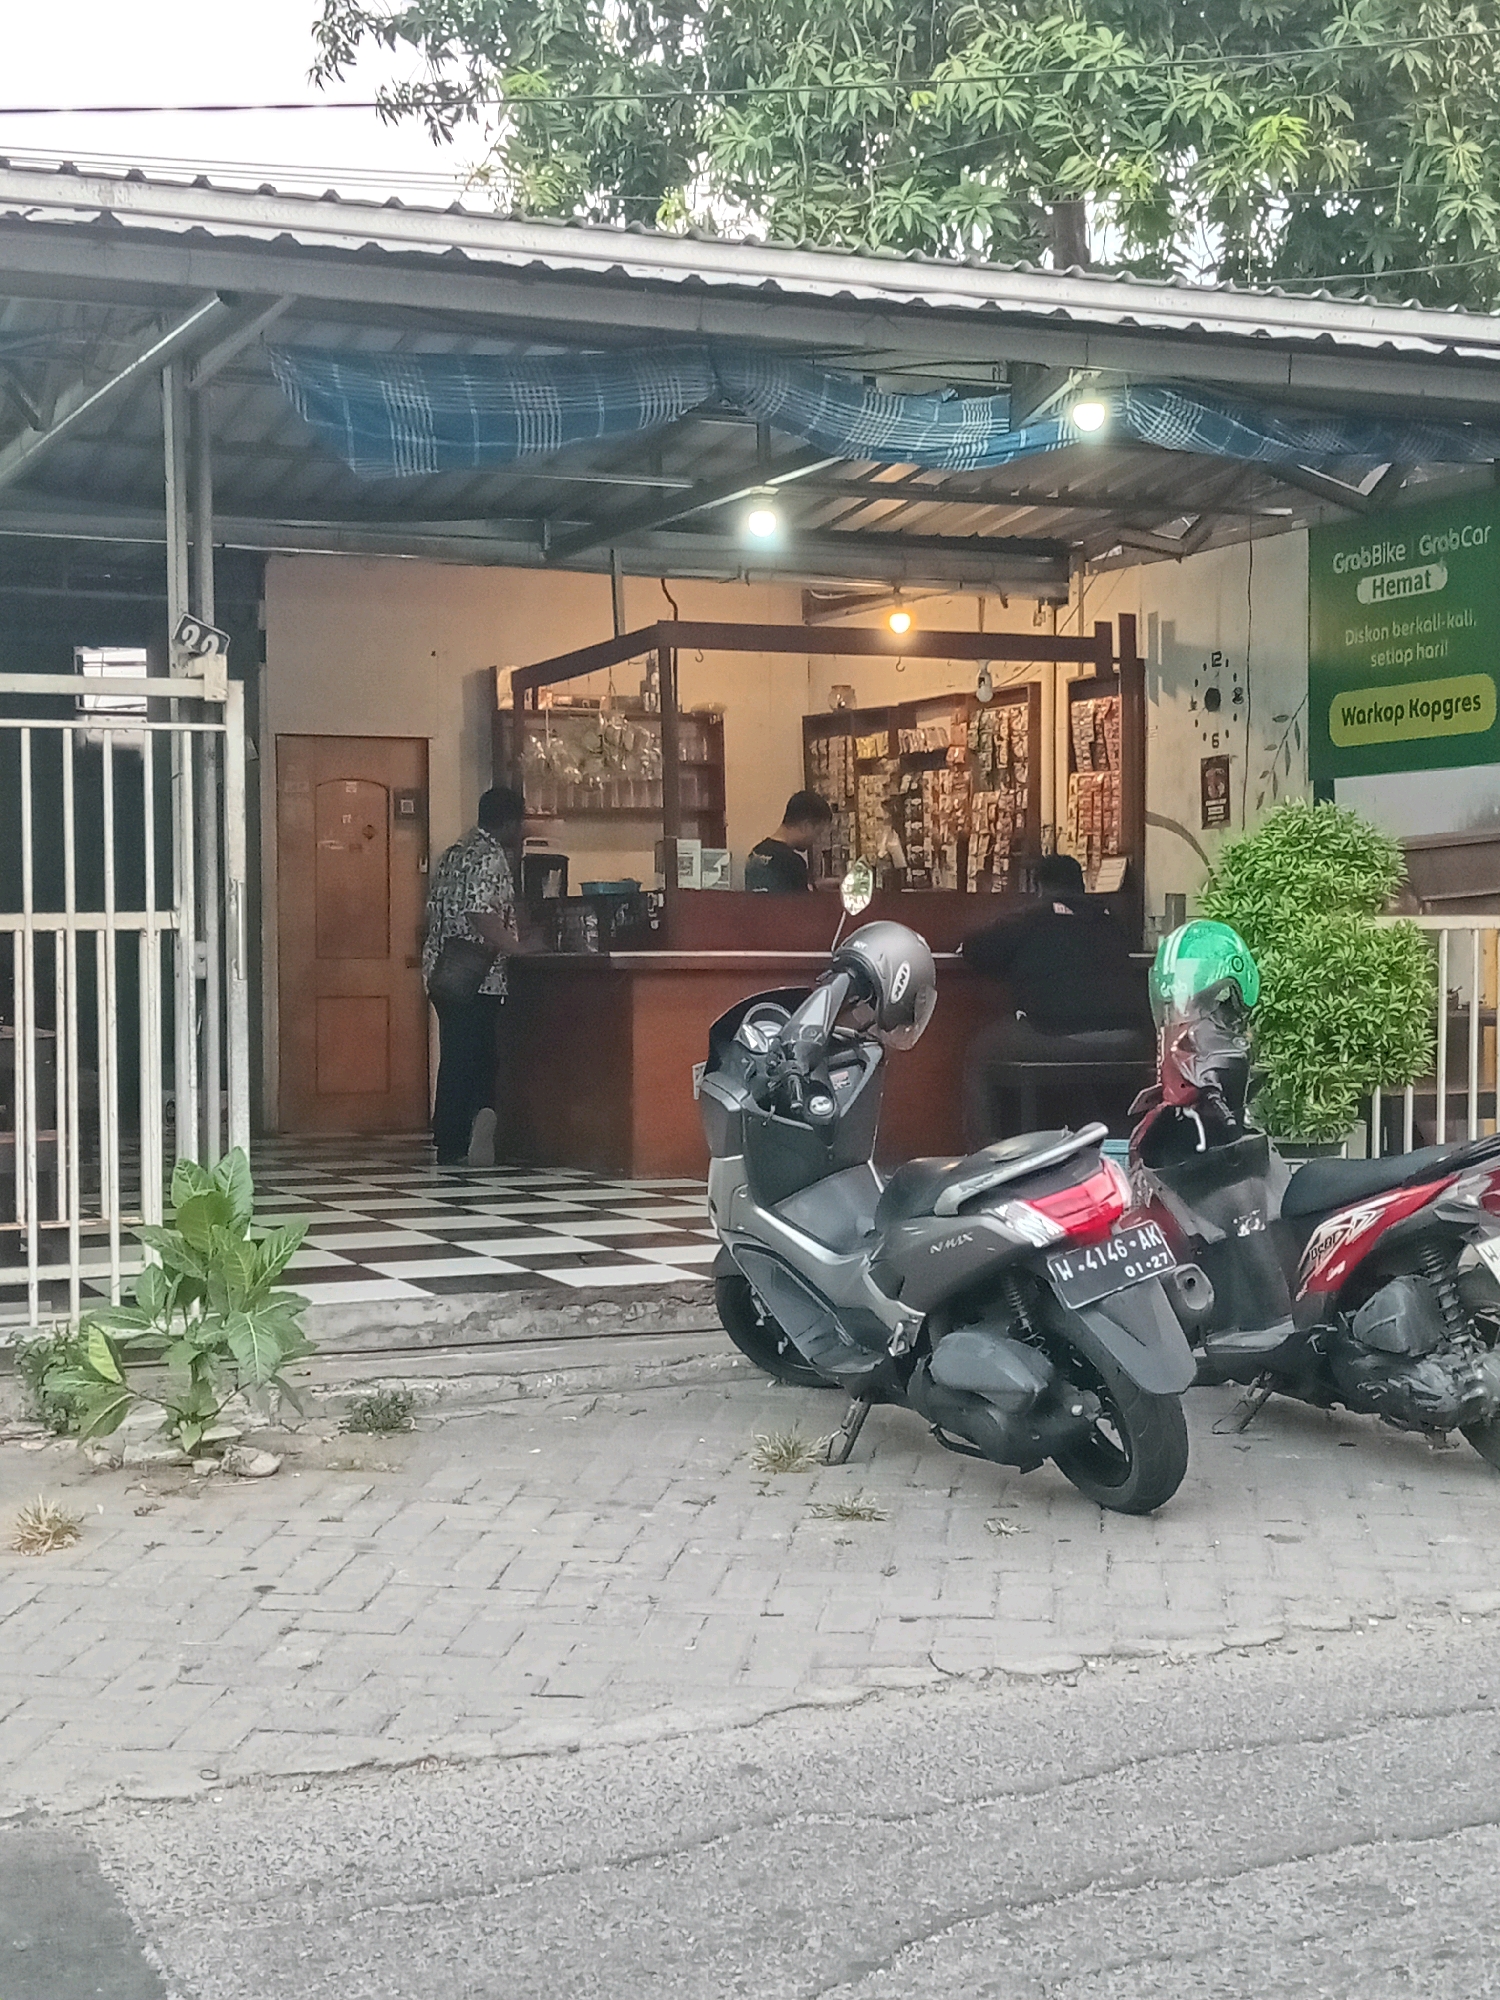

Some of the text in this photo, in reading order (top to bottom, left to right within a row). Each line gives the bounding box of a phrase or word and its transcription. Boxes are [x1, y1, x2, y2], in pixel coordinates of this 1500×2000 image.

[1333, 525, 1491, 574] GrabBike GrabCar
[1372, 569, 1431, 599] Hemat
[1345, 625, 1389, 646] Diskon
[1371, 646, 1413, 667] setiap
[1341, 694, 1481, 726] Warkop Kopgres
[1055, 1224, 1162, 1281] W 4146 AK
